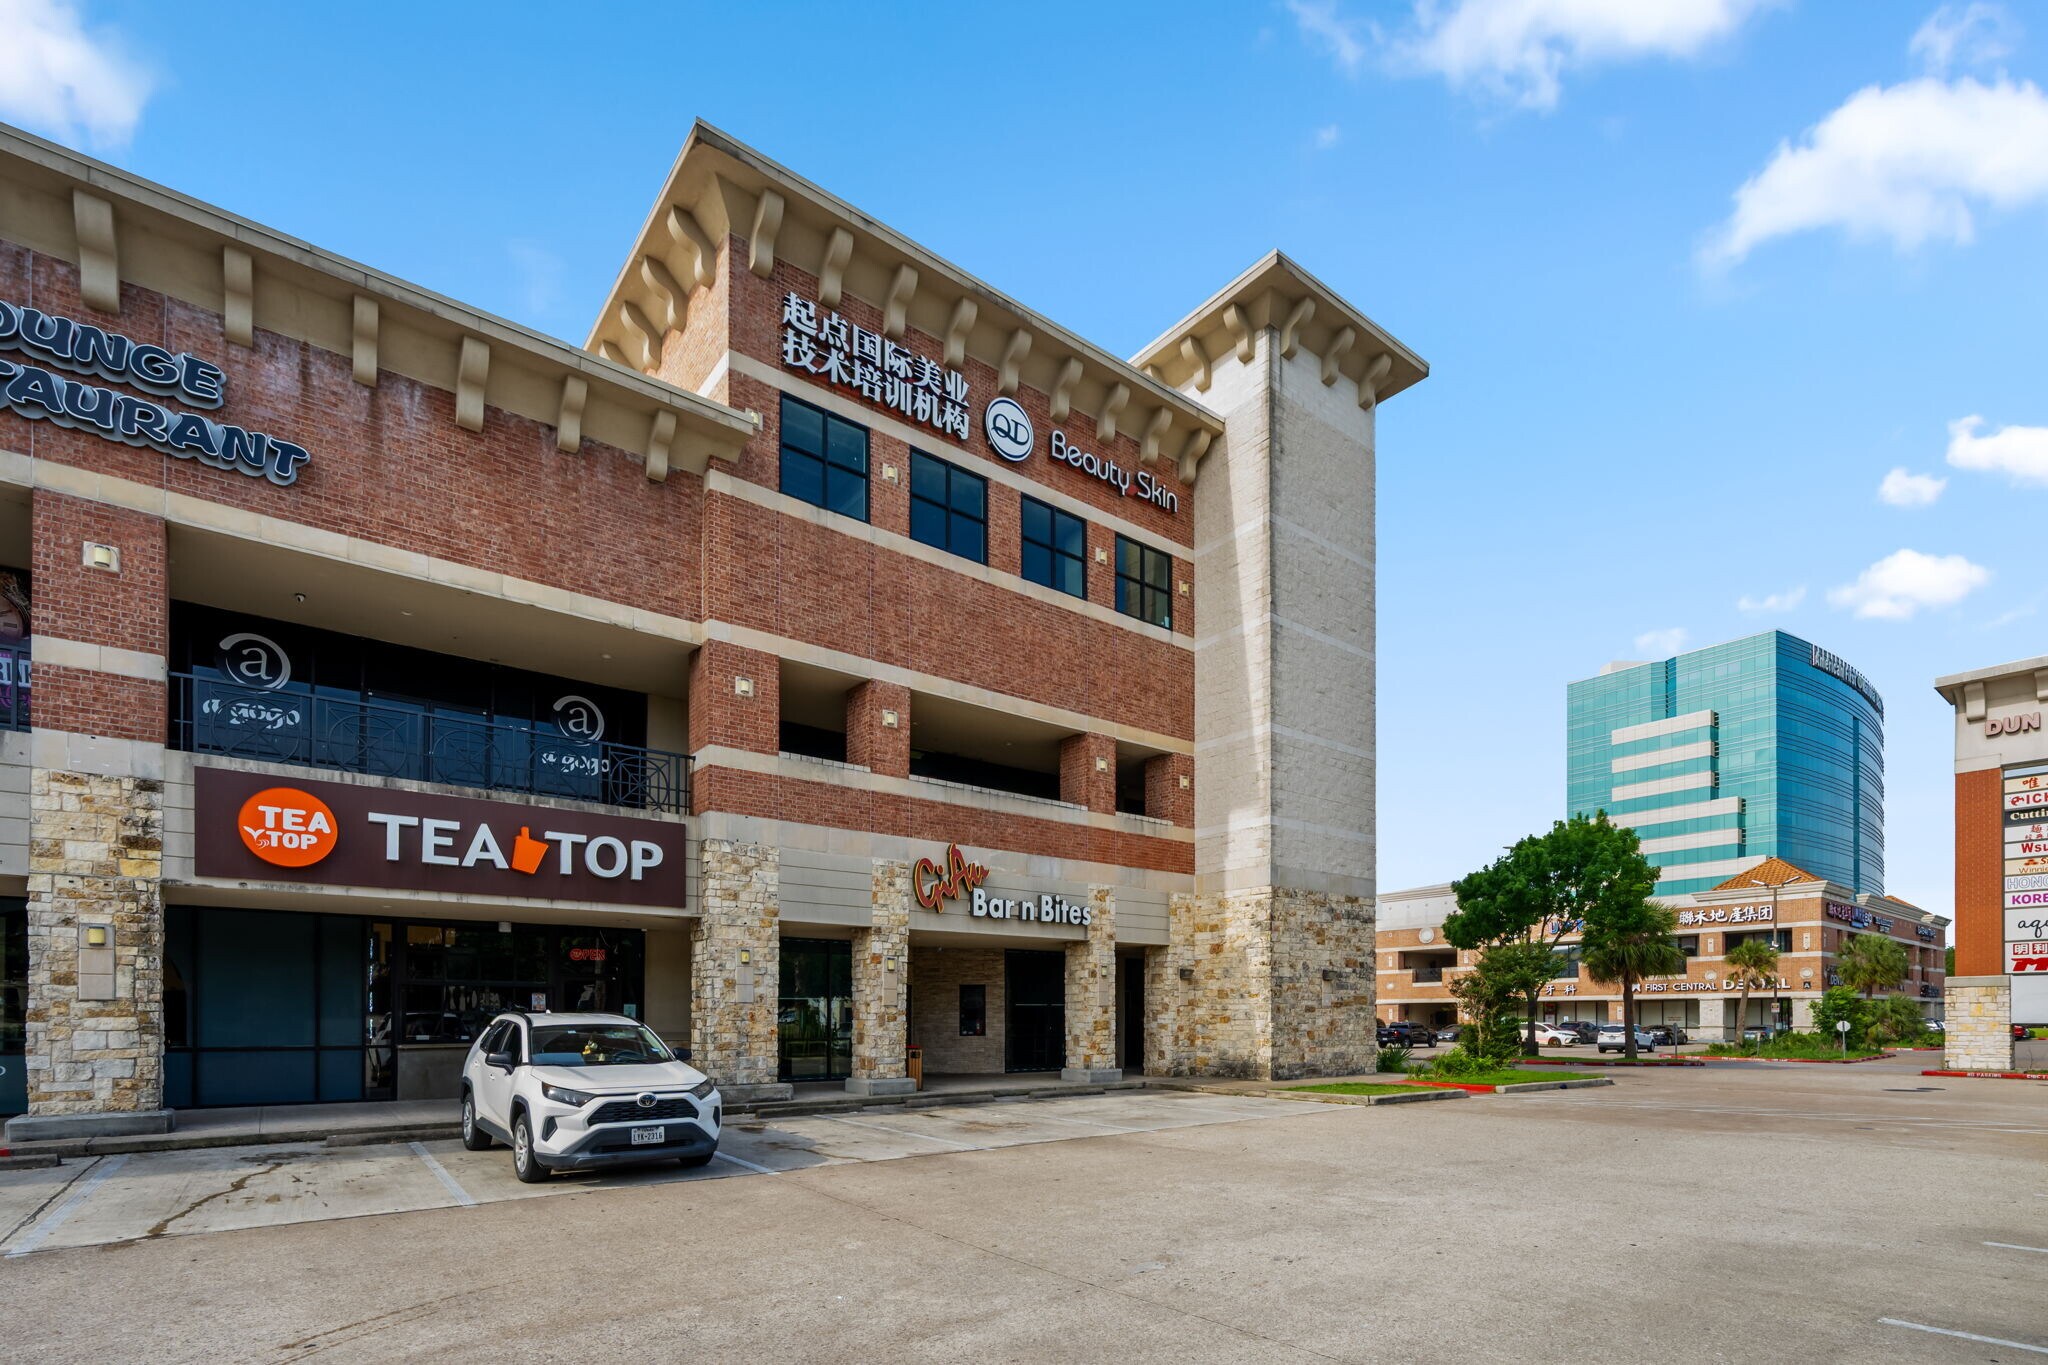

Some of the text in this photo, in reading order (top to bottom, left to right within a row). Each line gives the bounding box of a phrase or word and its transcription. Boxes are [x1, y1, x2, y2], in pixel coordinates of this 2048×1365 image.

[783, 291, 970, 408] 起点国际美业
[782, 328, 970, 440] 技术培训机构
[1051, 430, 1178, 513] Beauty Skin
[1985, 711, 2041, 737] DUN
[258, 805, 331, 835] TEA
[2010, 808, 2048, 821] Cutti
[267, 831, 318, 850] TOP
[368, 811, 664, 882] TEA TOP
[970, 888, 1092, 926] Bar n Bites
[1645, 977, 1791, 992] FIRST CENTRAL DETL
